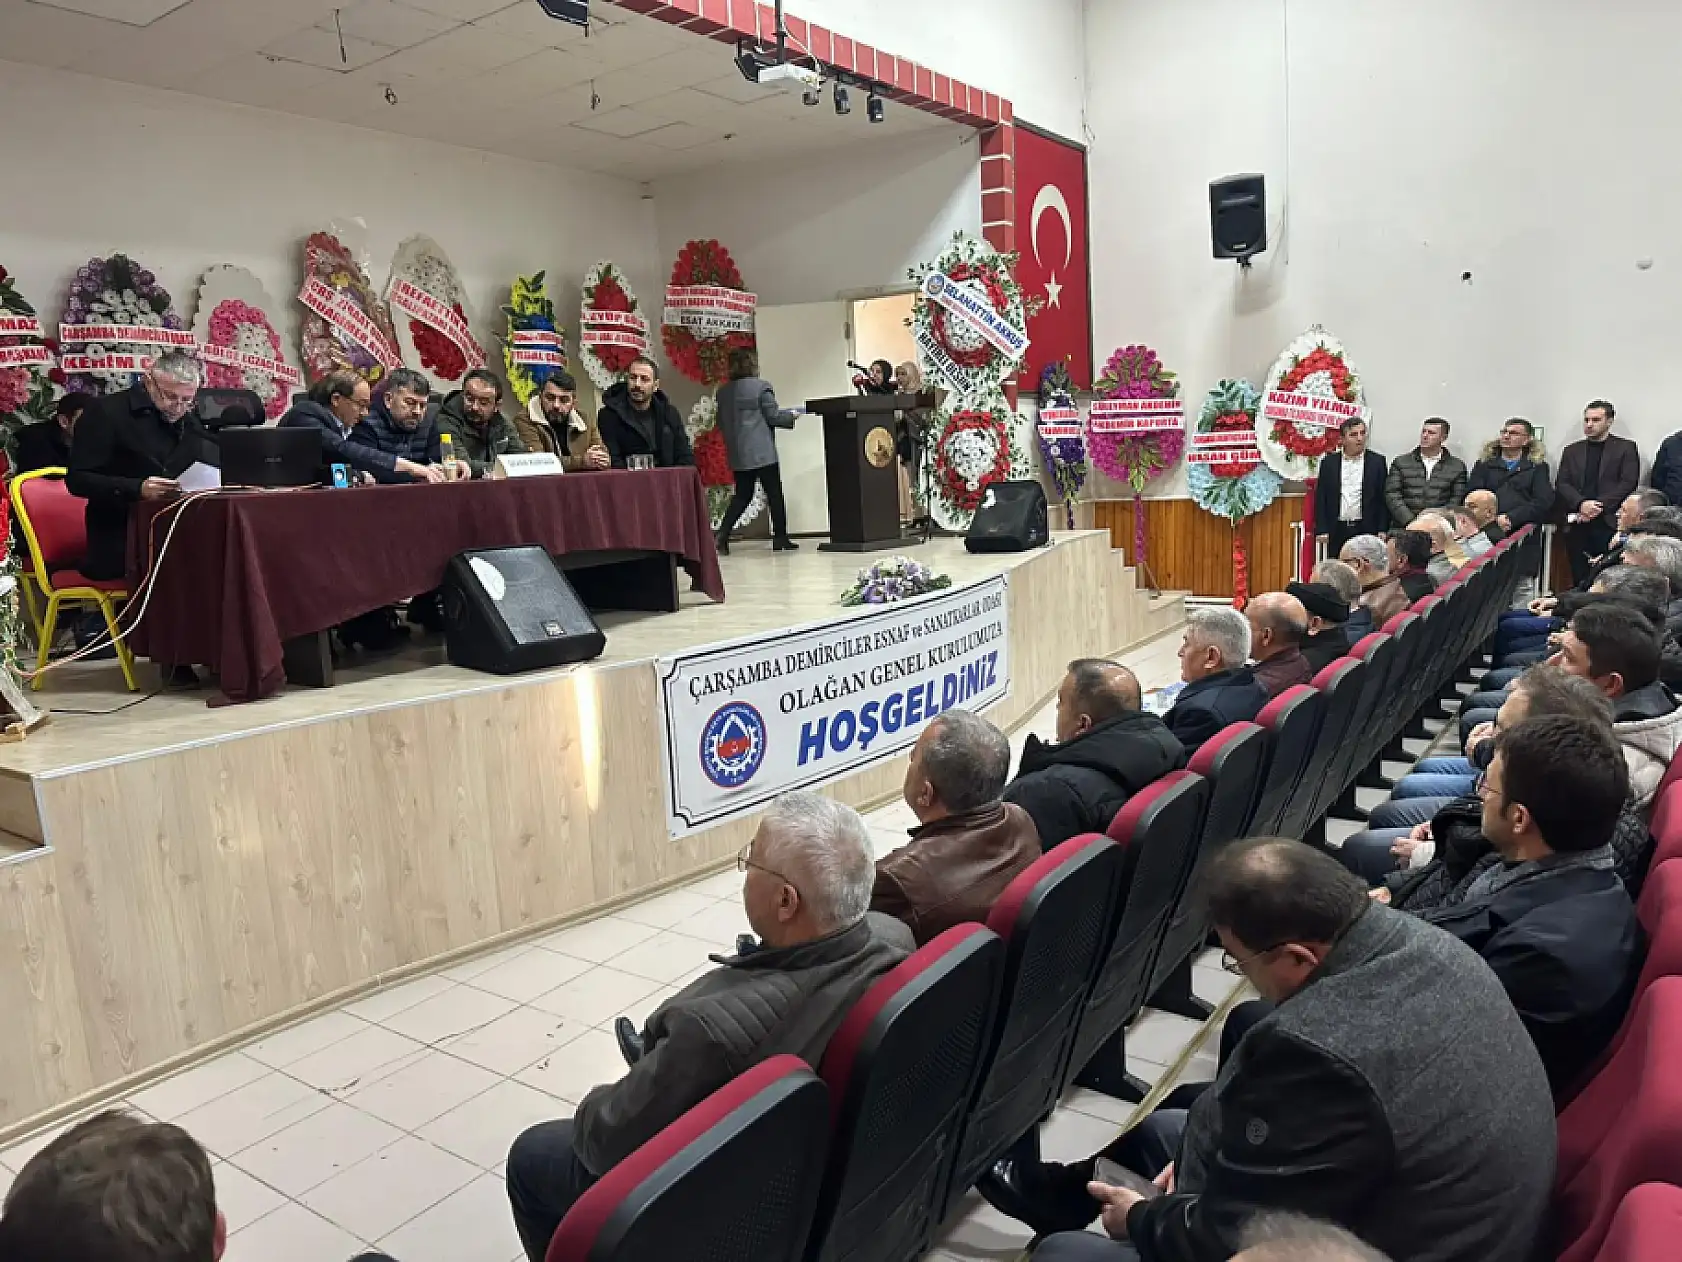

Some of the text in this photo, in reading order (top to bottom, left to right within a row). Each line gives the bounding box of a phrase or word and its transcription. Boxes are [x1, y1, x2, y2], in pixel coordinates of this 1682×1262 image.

[944, 283, 995, 325] SELAHATTİN
[946, 363, 972, 391] OLSUN
[1268, 391, 1308, 407] KAZIM
[1311, 396, 1358, 416] YILMAZ
[1188, 451, 1227, 462] HASAN
[689, 658, 783, 705] ÇARŞAMBA
[785, 636, 873, 675] DEMİRCİLER
[874, 623, 911, 653] ESNAF
[912, 625, 924, 640] ve
[779, 619, 1003, 714] OLAĞAN GENEL KURULUMUZA
[797, 650, 999, 768] HOŞGELDİNİZ
